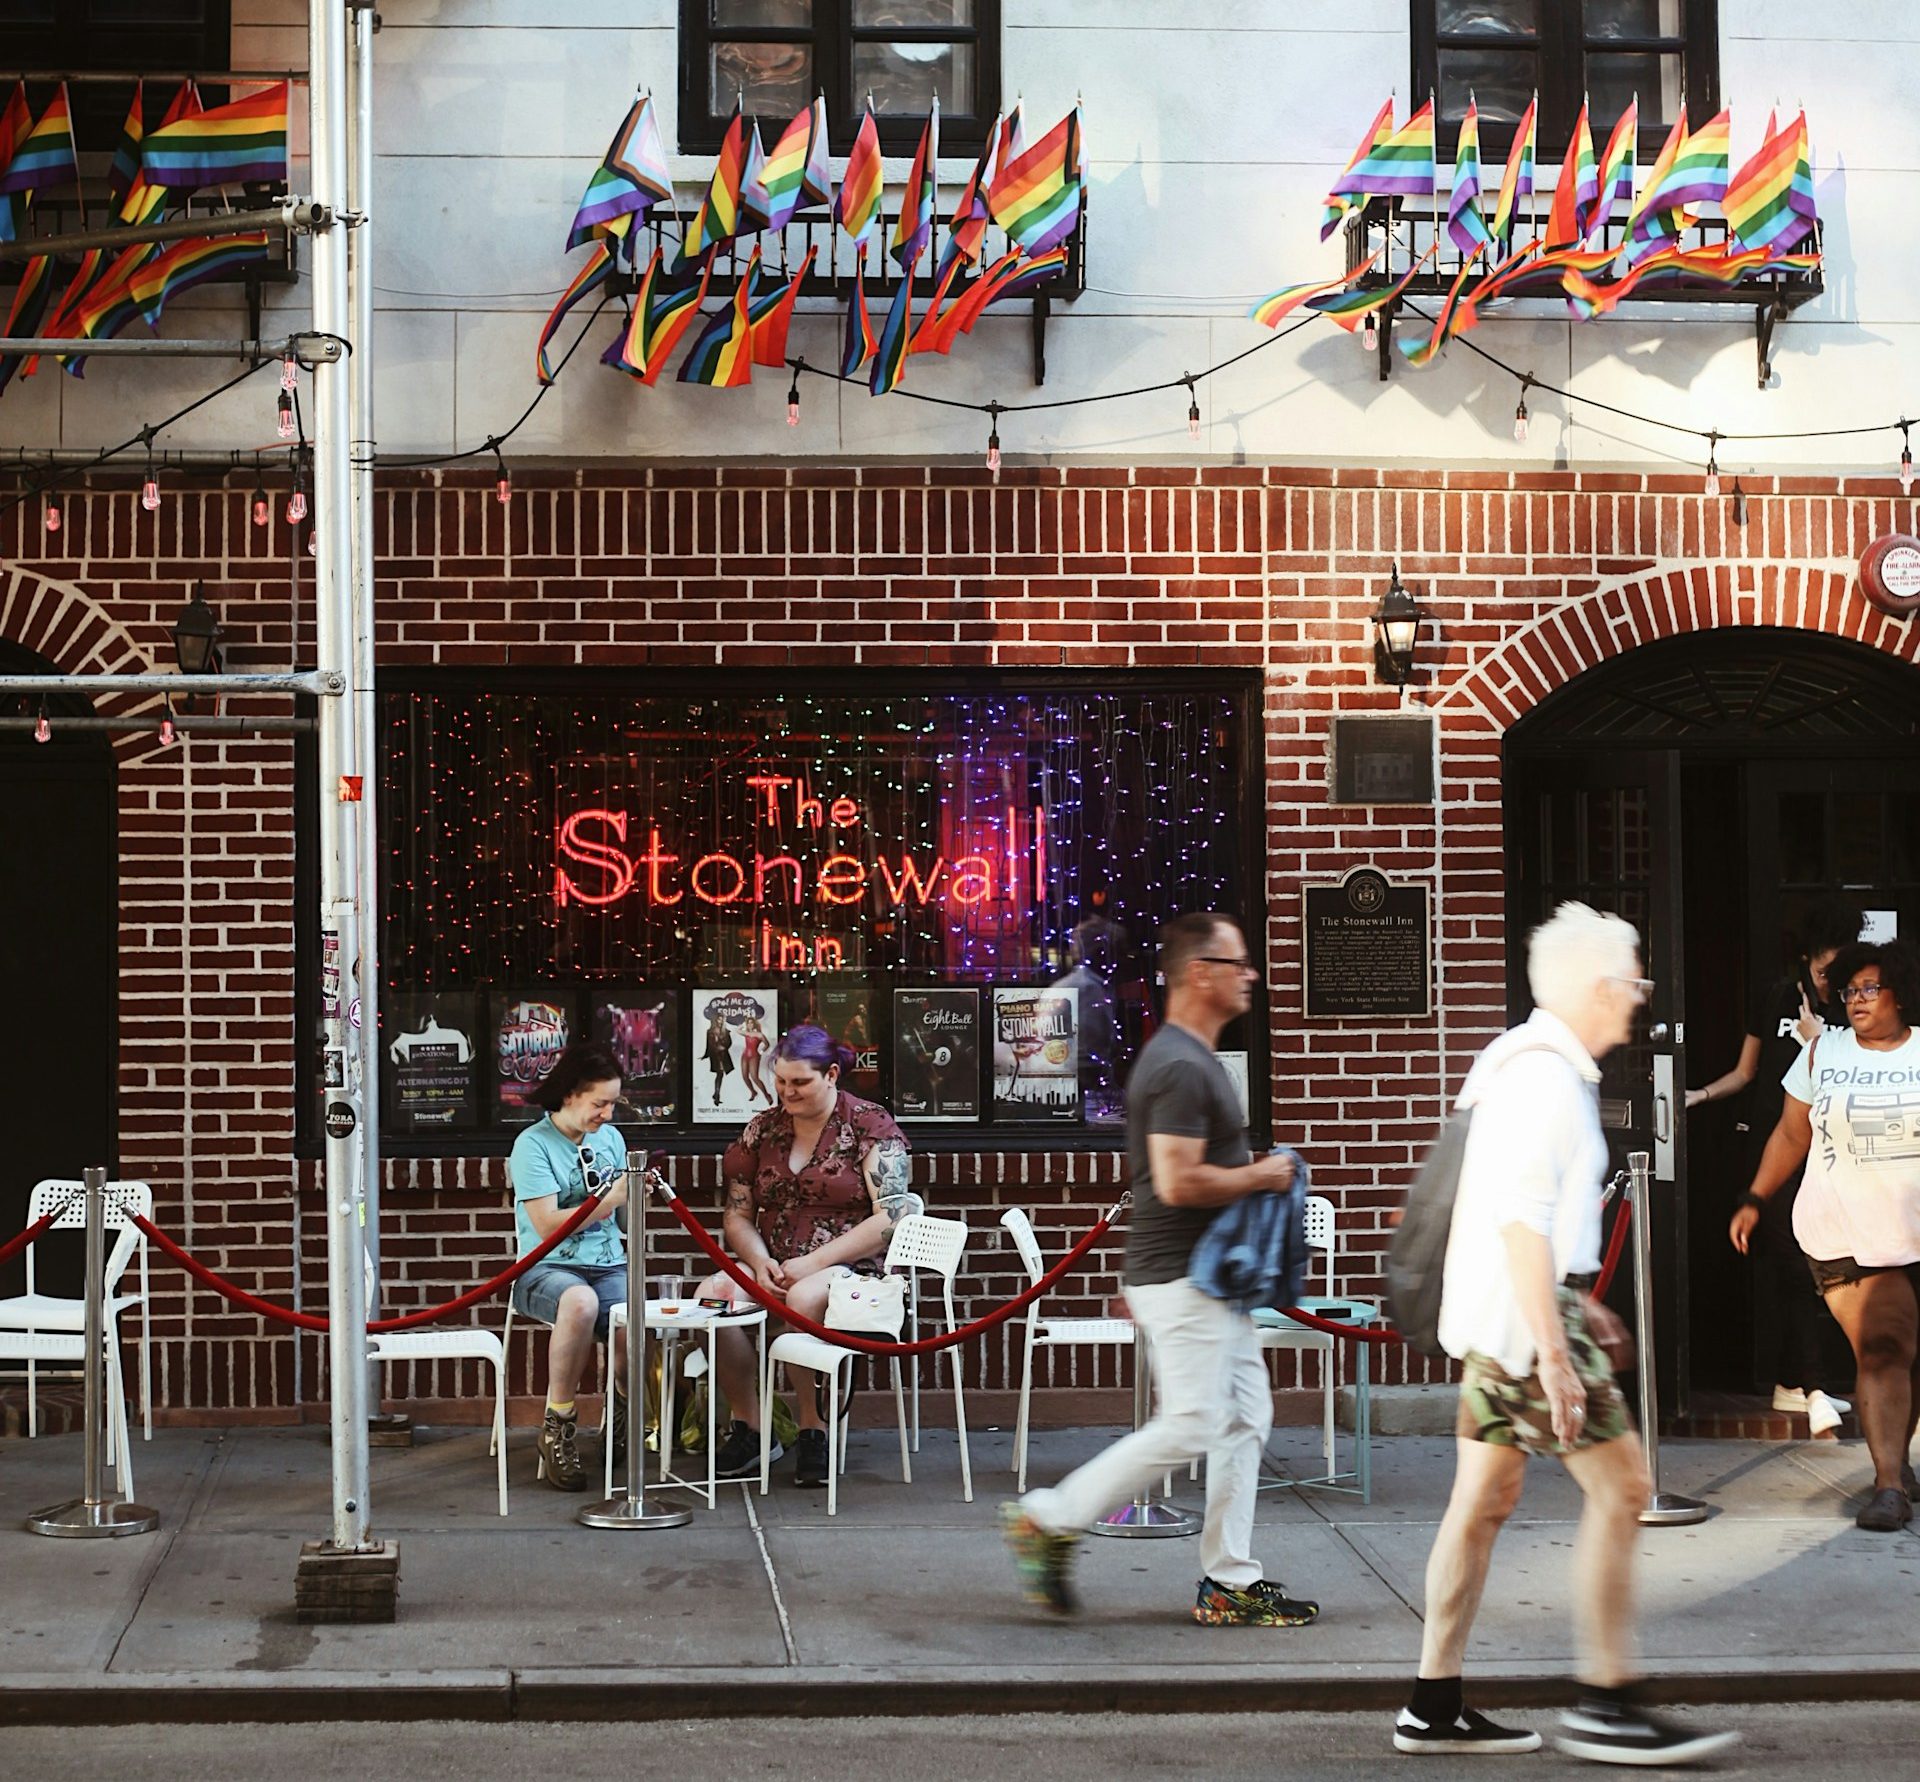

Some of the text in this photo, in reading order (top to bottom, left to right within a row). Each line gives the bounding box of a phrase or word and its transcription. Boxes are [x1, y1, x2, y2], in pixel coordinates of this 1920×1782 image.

[1888, 550, 1918, 560] SPRINKLER
[747, 778, 859, 827] The
[554, 805, 1045, 907] Stonewall
[1320, 916, 1413, 926] The Stonewall Inn
[761, 918, 842, 970] Inn
[923, 1008, 973, 1030] Eight Ball
[1000, 1004, 1031, 1014] PIANO
[1002, 1015, 1068, 1038] STONEWALL
[500, 1027, 569, 1056] SATURDAY
[940, 1051, 946, 1062] 8
[397, 1078, 453, 1086] ALTERNATING
[1815, 1093, 1836, 1172] カメラ
